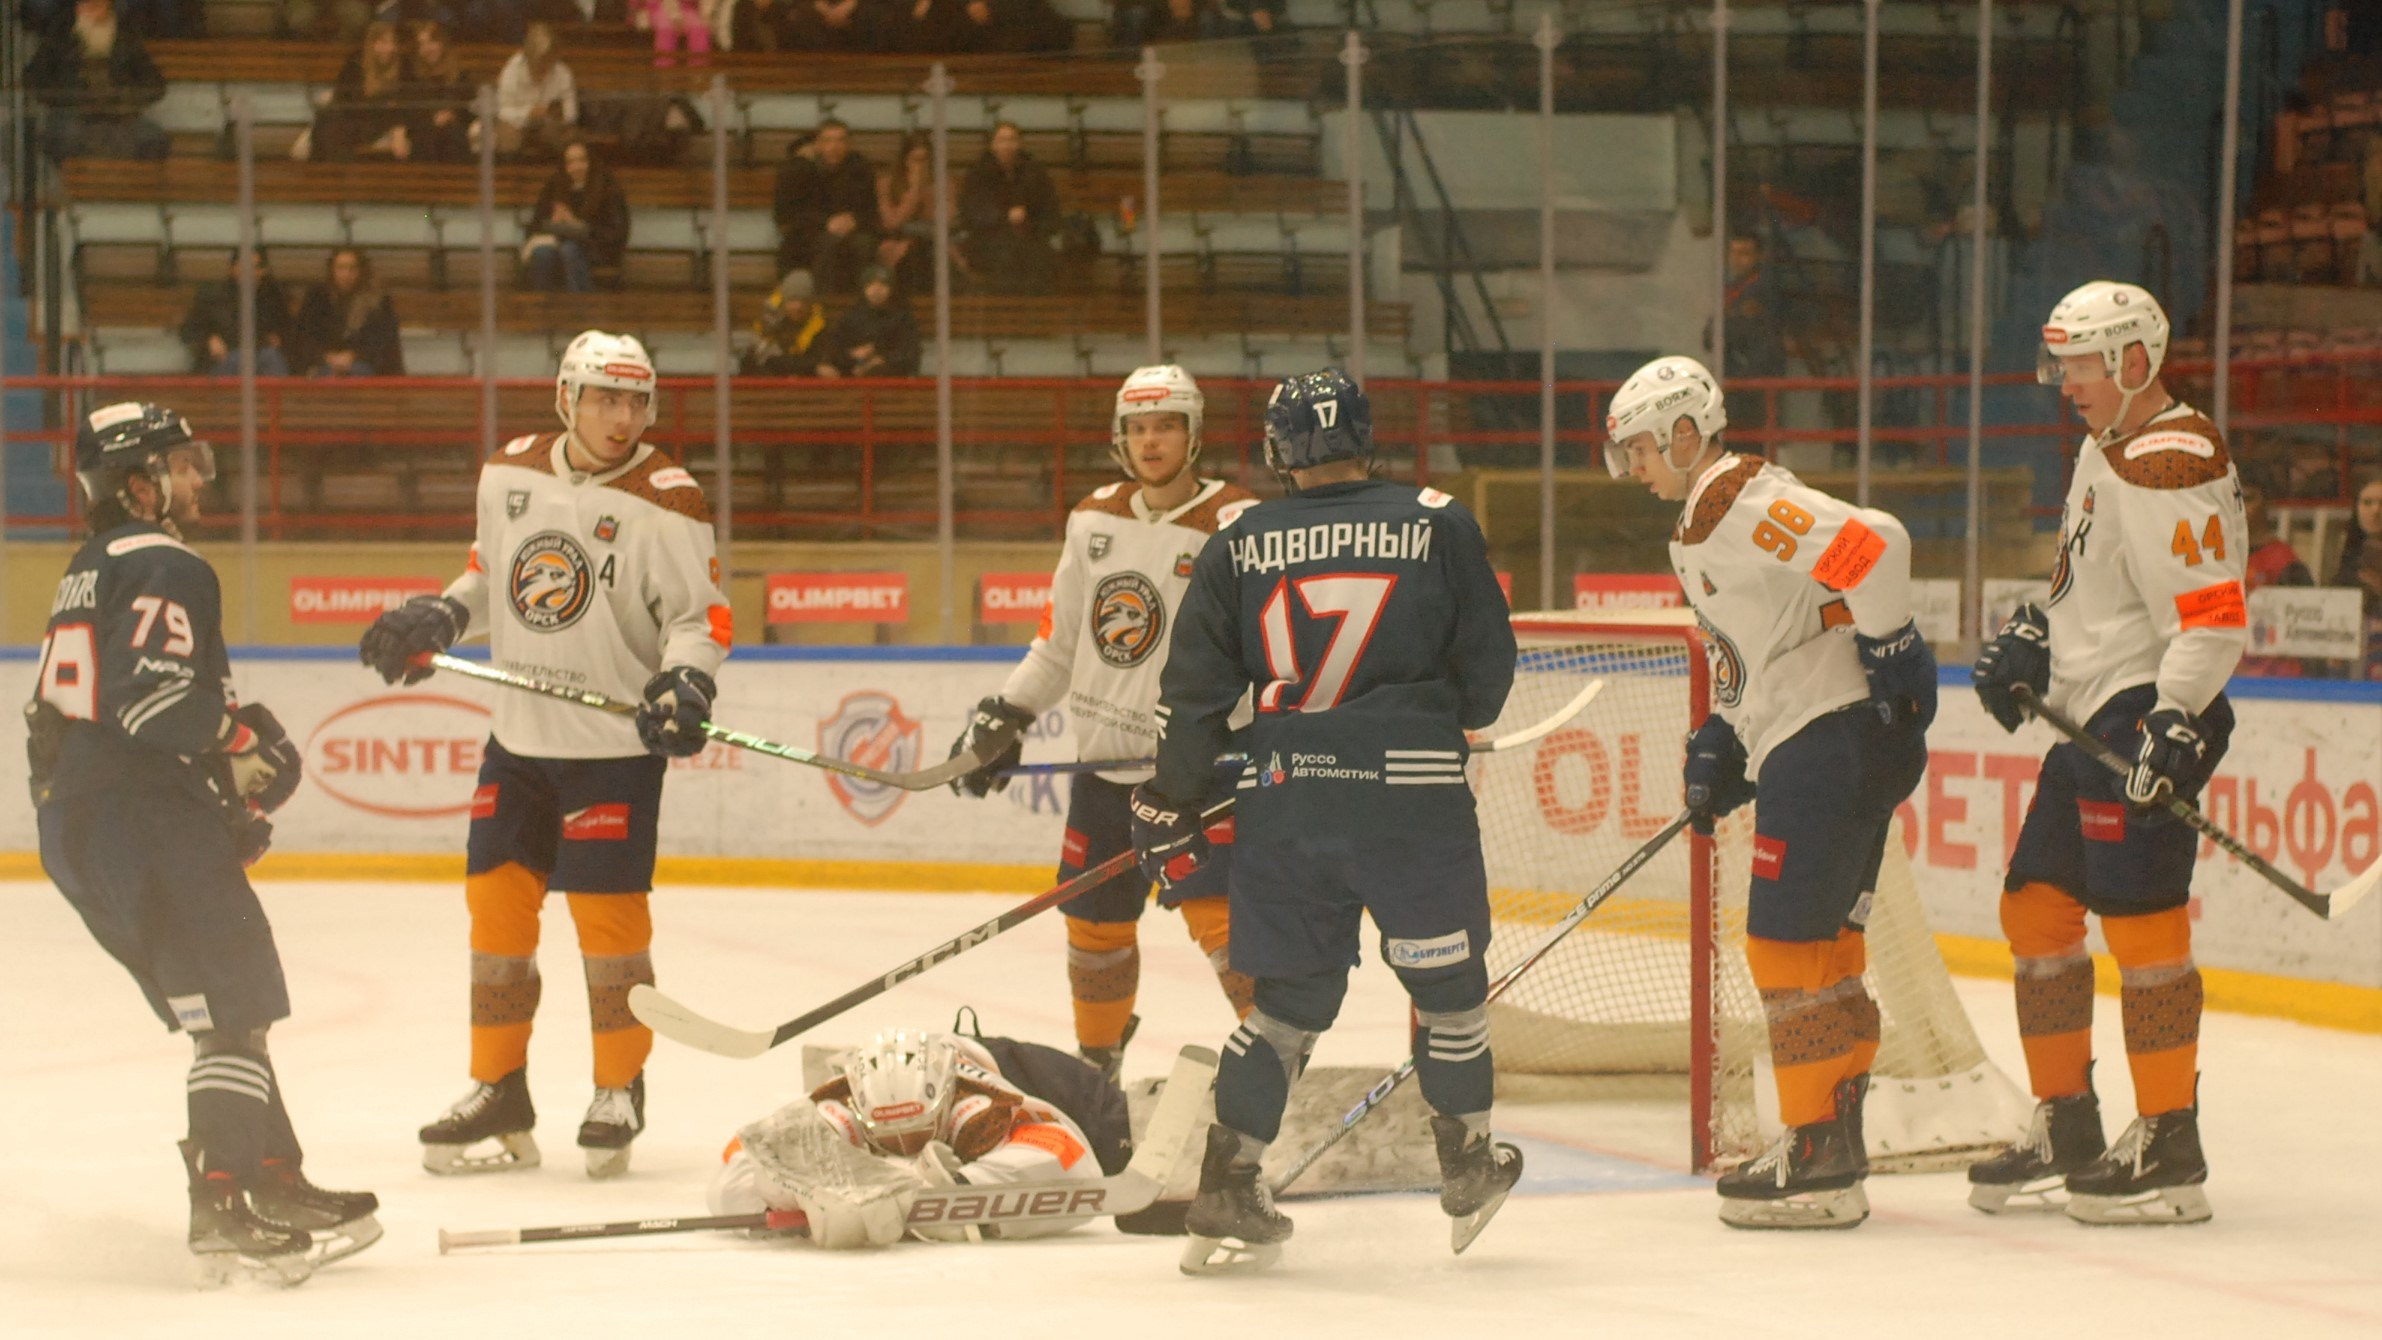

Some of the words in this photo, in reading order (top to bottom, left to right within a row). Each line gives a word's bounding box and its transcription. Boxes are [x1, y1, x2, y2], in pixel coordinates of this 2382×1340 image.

[1312, 400, 1338, 429] 17
[1752, 498, 1816, 562] 98
[2171, 514, 2226, 567] 44
[1228, 518, 1433, 578] НАДВОРНЫЙ
[770, 586, 904, 610] OLIMPBET
[984, 586, 1053, 610] OLIM
[130, 595, 195, 659] 79
[525, 608, 560, 626] ОРСК
[1103, 644, 1133, 663] ОРСК
[1259, 570, 1400, 714] 17
[321, 737, 485, 765] SINTE
[1291, 751, 1337, 767] Руссо
[1291, 766, 1380, 781] Автоматик
[1130, 792, 1179, 827] UER
[2197, 747, 2382, 893] льфа
[884, 918, 999, 991] CCM
[872, 1103, 923, 1119] OLIMPBET
[906, 1188, 1107, 1224] BAUER
